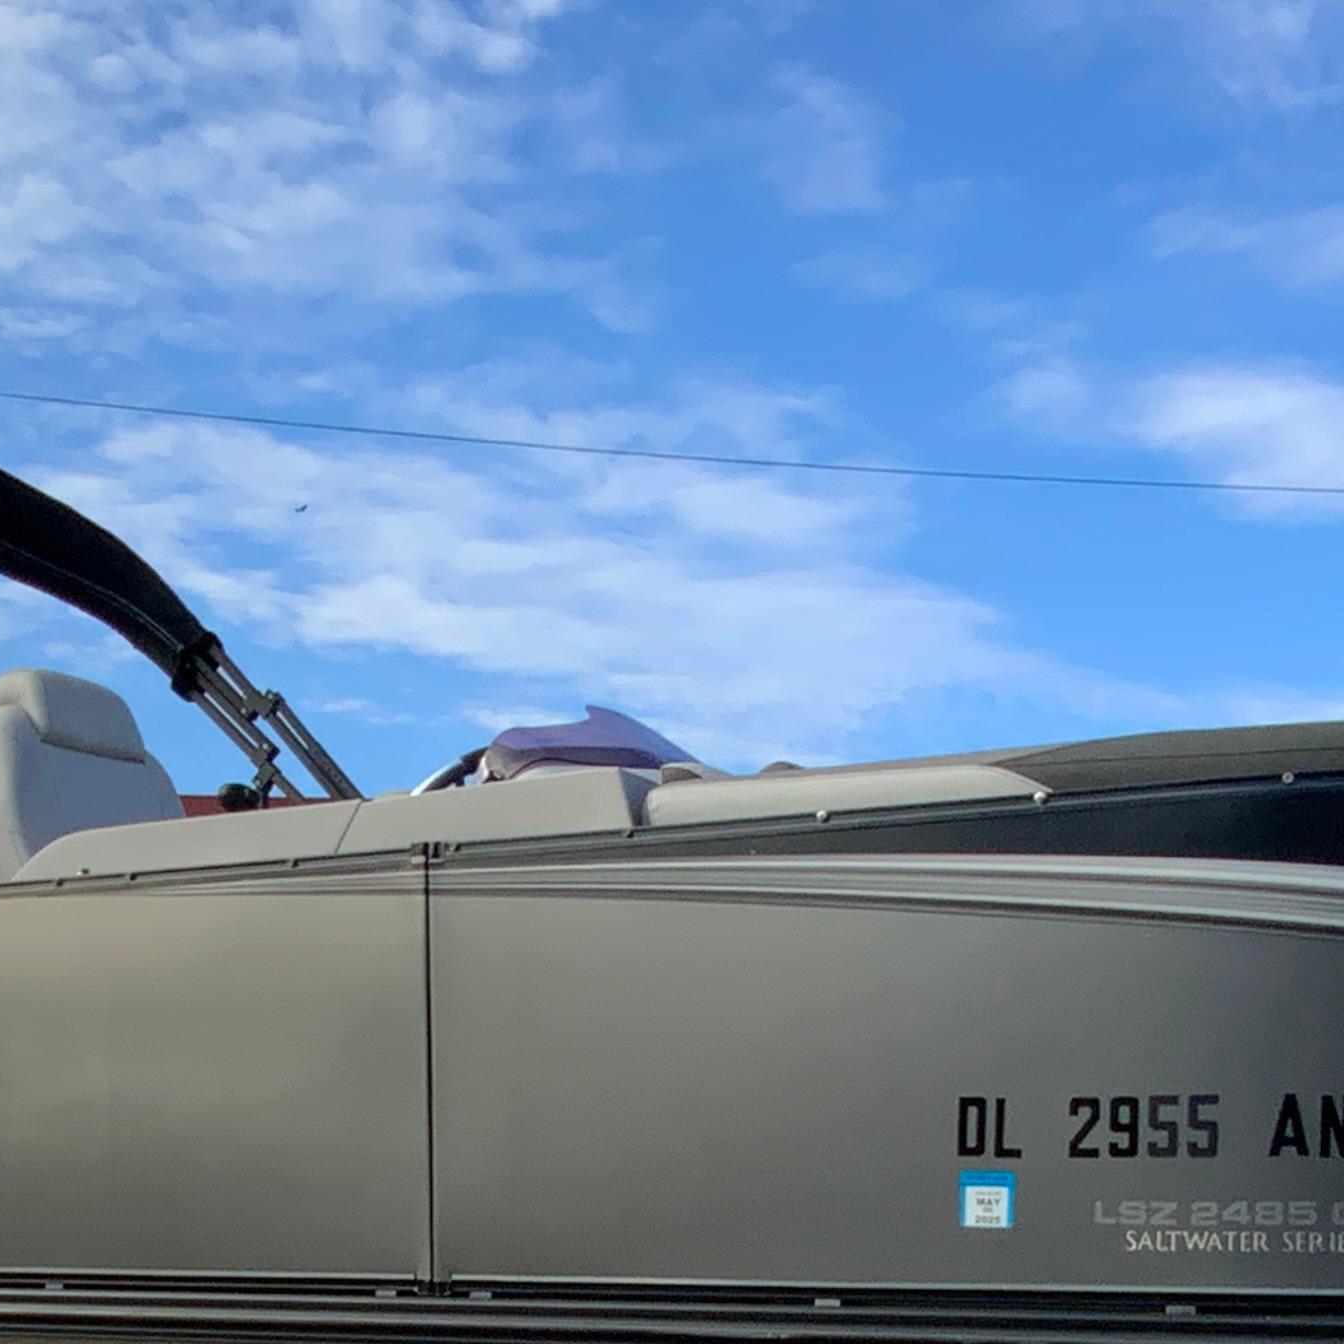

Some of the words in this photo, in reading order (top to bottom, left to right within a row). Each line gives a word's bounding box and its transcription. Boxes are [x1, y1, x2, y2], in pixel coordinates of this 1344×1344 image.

[958, 1097, 1022, 1158] DL
[1068, 1095, 1219, 1158] 2955
[1093, 1200, 1178, 1226] LSZ
[1190, 1200, 1317, 1227] 2485
[1125, 1230, 1269, 1252] SALTWATER
